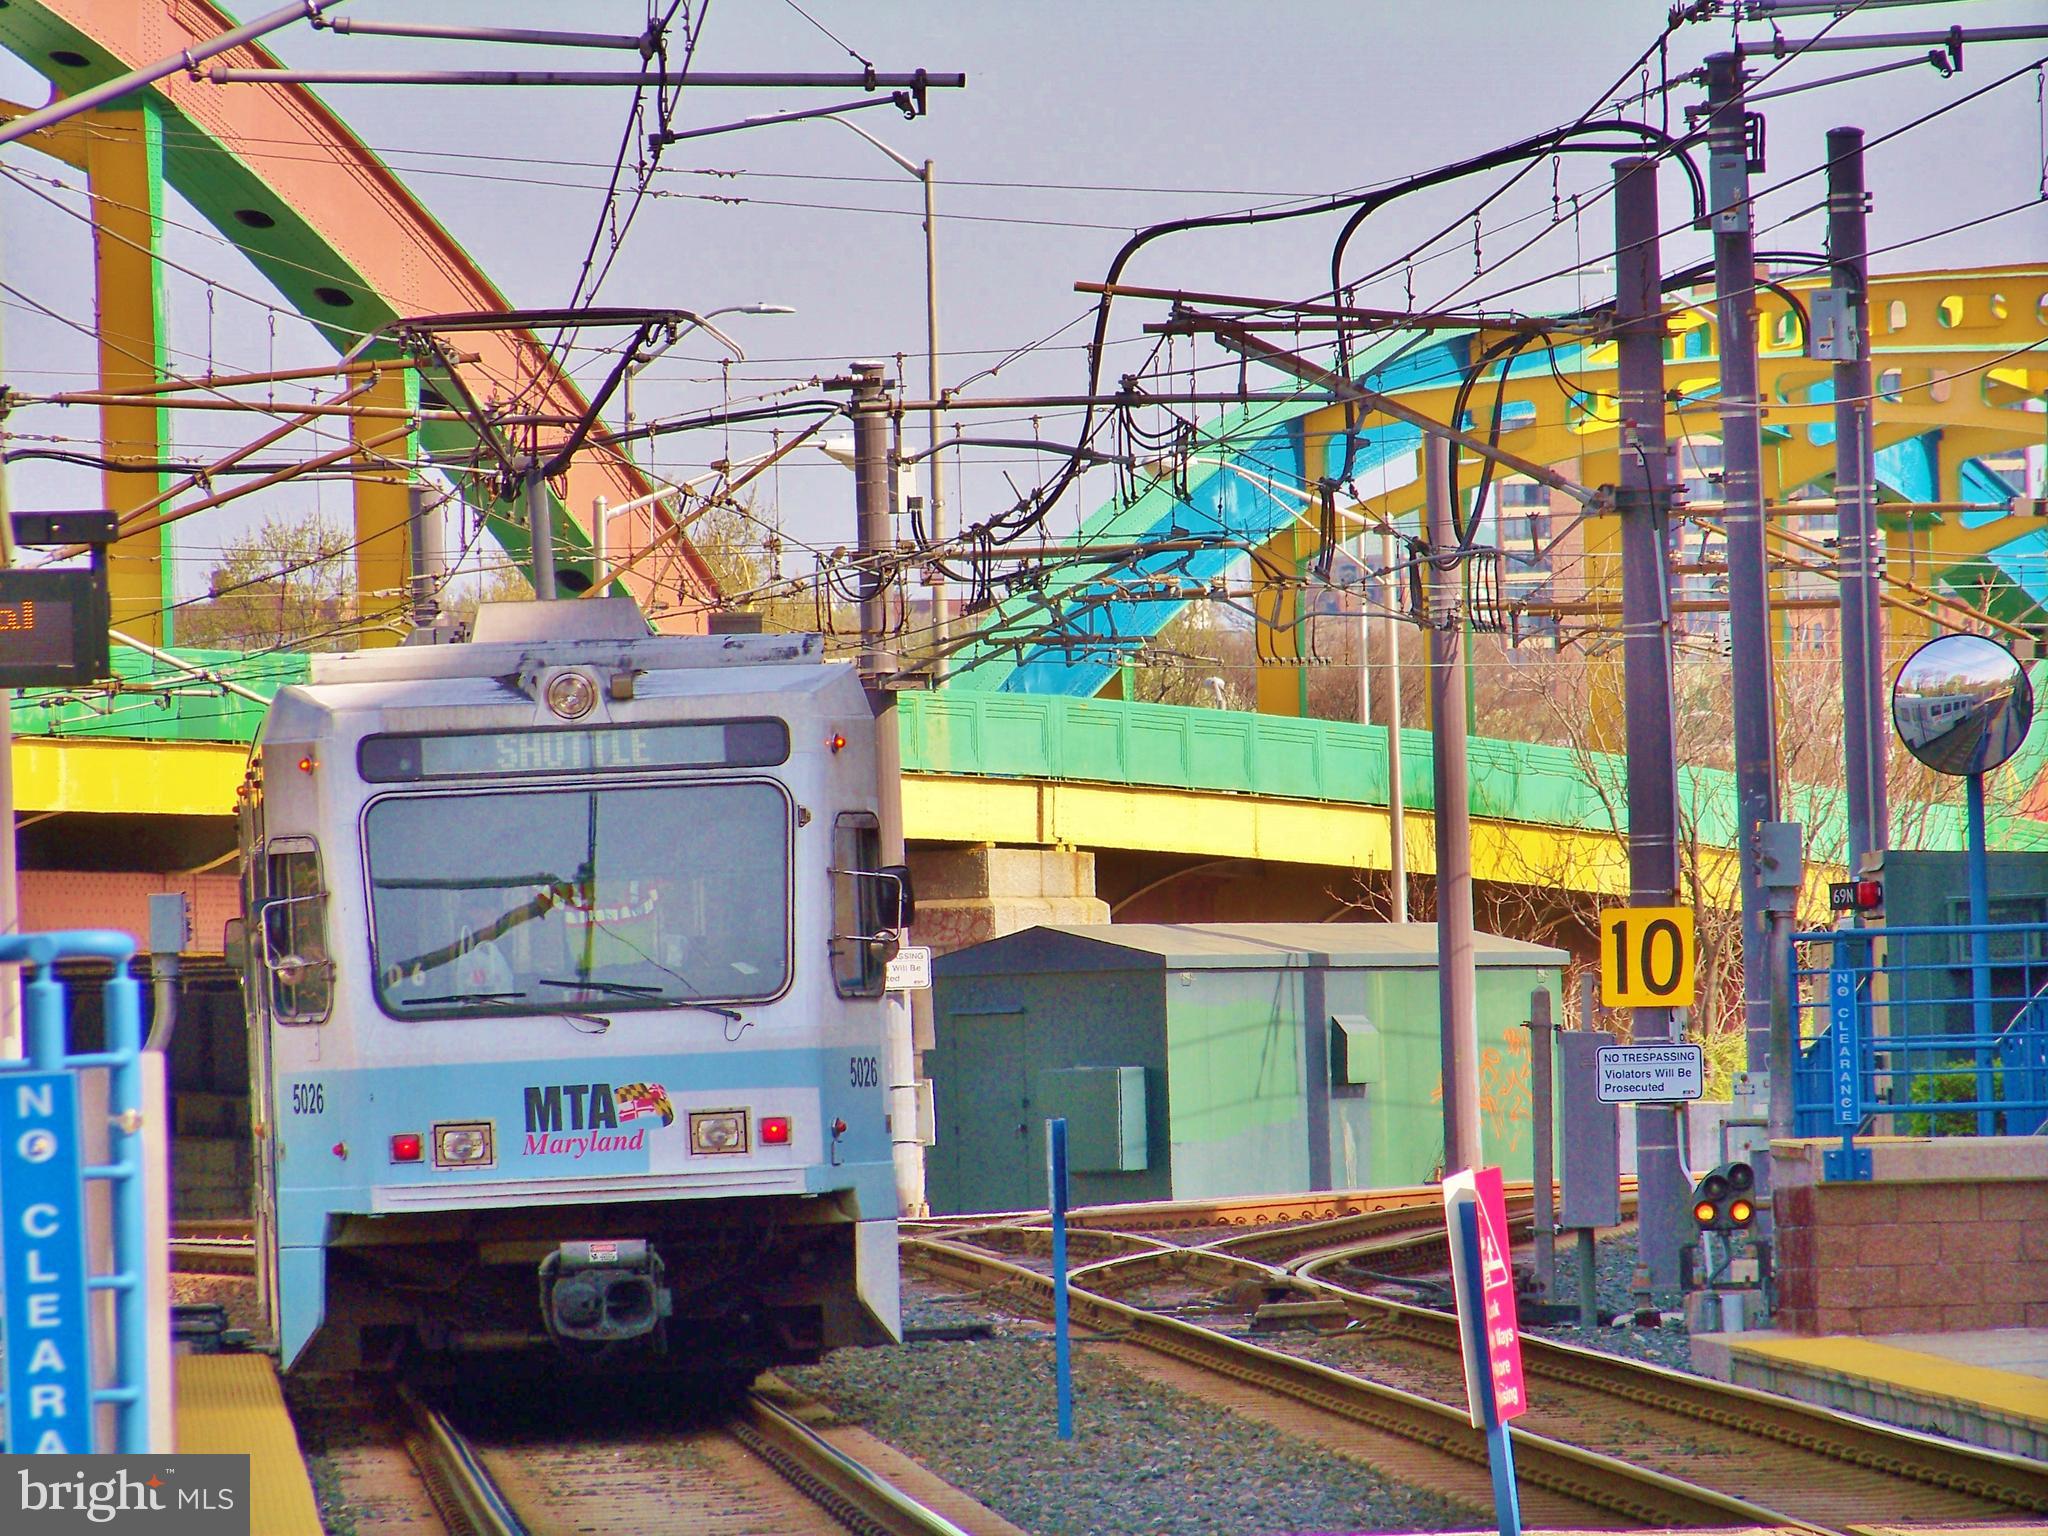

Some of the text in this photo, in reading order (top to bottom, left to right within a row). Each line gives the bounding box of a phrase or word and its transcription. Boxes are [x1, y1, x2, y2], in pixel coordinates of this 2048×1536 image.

[496, 728, 650, 768] SHUTTLE
[1833, 888, 1854, 904] 69N
[1611, 918, 1684, 996] 10
[1604, 1052, 1695, 1063] NO TRESPASSING
[1837, 974, 1853, 1121] NO CLEARANCE
[850, 1056, 878, 1088] 5026
[1604, 1082, 1665, 1093] Prosecuted
[1605, 1068, 1692, 1079] Violators Will Be
[293, 1083, 324, 1115] 5026
[523, 1083, 618, 1133] MTA
[17, 1084, 57, 1164] NO
[523, 1128, 645, 1159] Maryland
